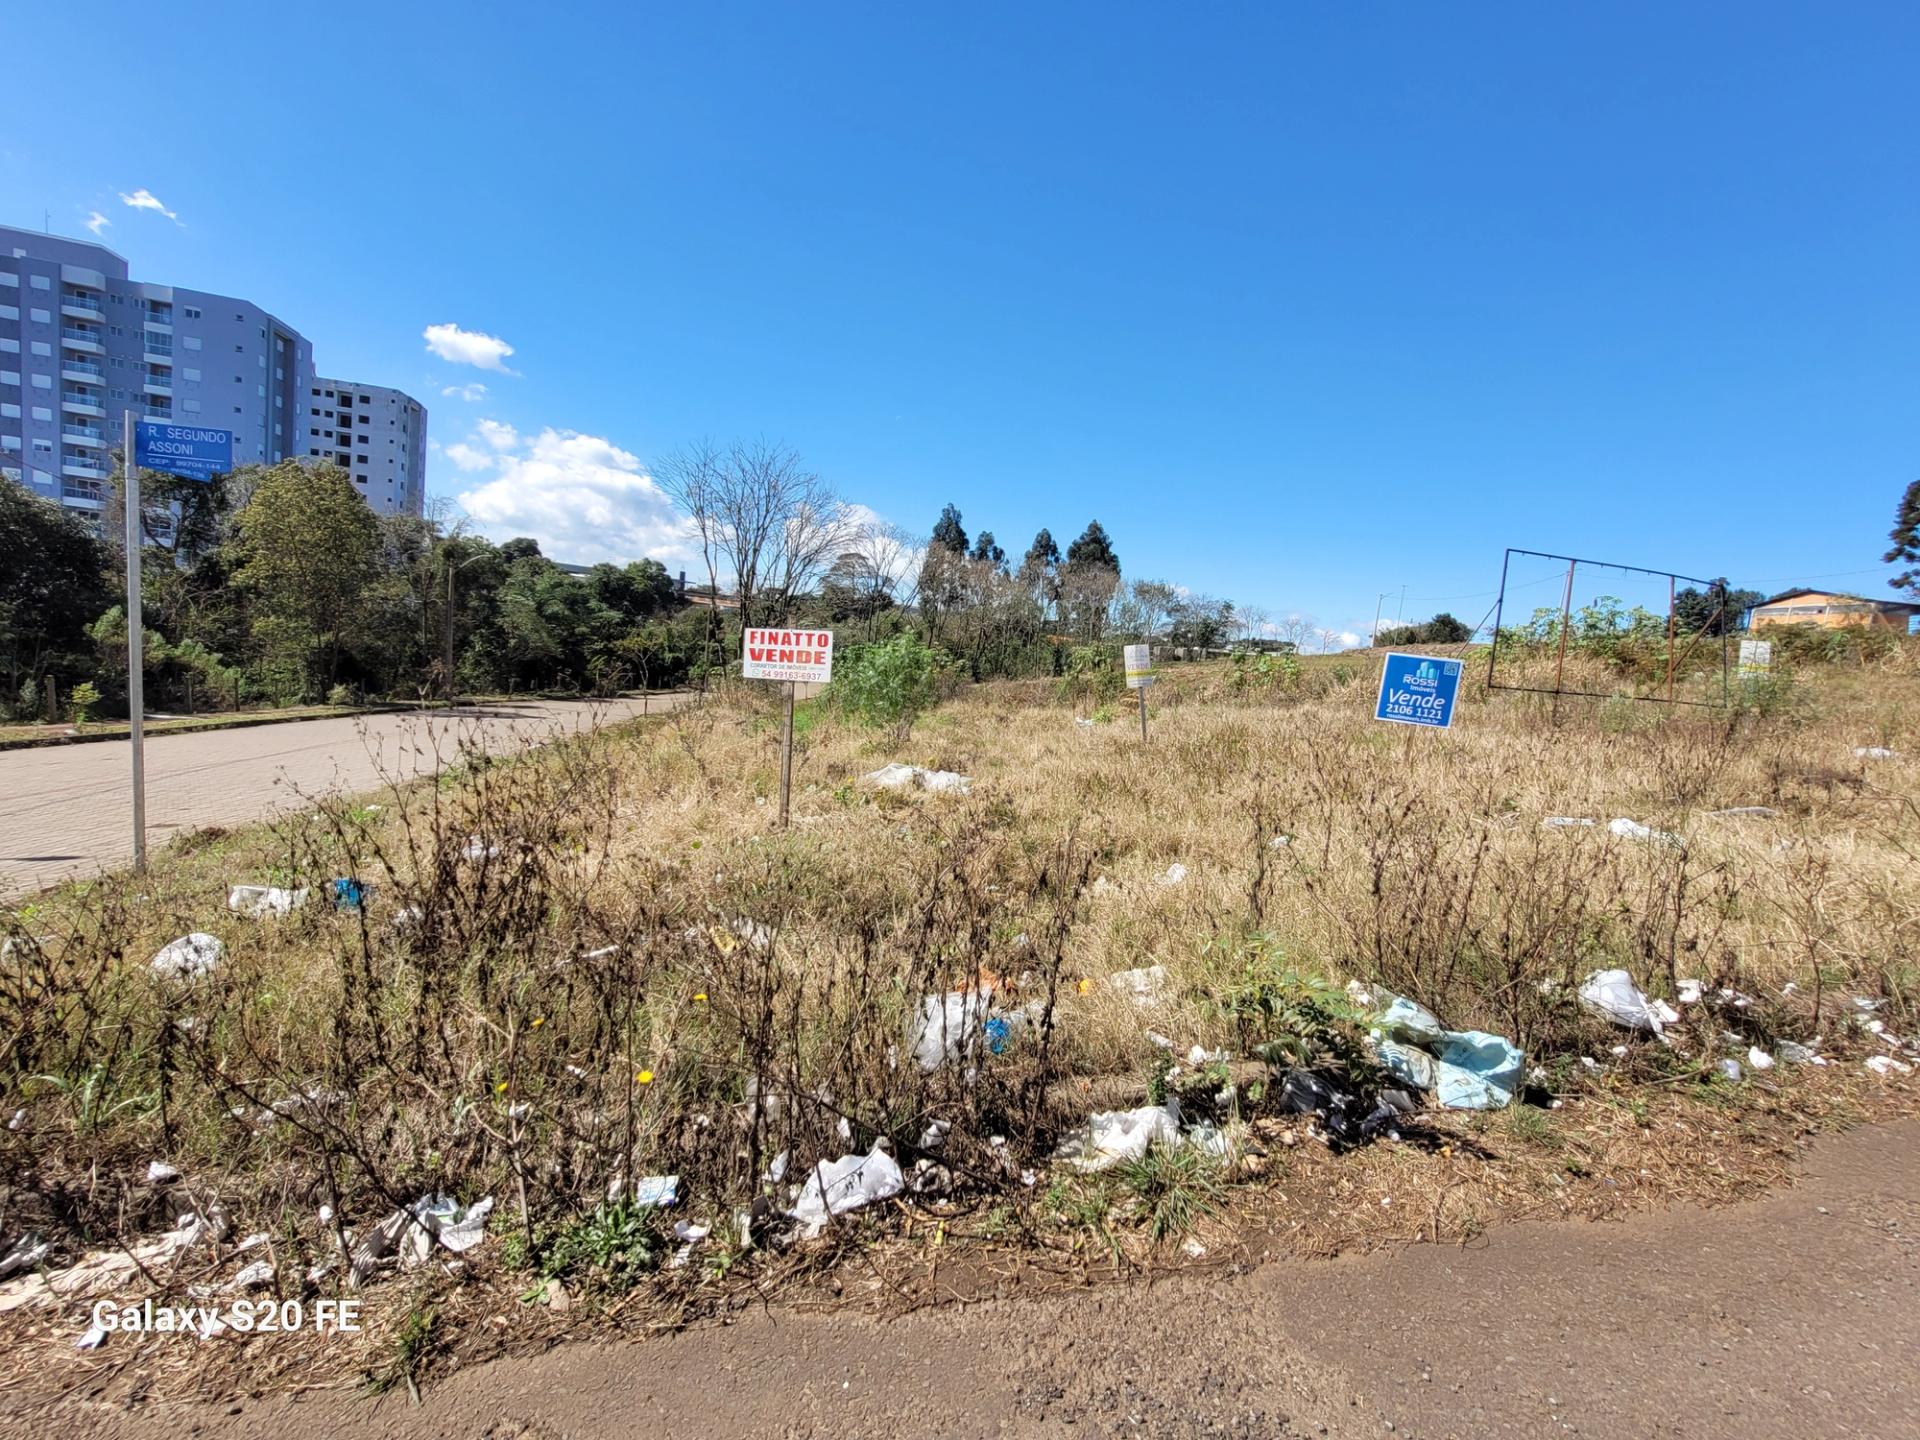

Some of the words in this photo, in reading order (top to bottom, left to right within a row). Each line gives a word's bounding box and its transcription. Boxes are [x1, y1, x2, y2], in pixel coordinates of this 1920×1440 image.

[148, 425, 160, 437] R.
[167, 427, 226, 444] SEGUNDO
[147, 440, 193, 455] ASSONI
[750, 631, 829, 648] FINATTO
[749, 648, 826, 665] VENDE
[761, 669, 772, 678] 54
[1402, 675, 1438, 688] ROSSI
[1388, 687, 1446, 710] Vende
[1385, 703, 1414, 716] 2106
[1415, 707, 1443, 720] 1121
